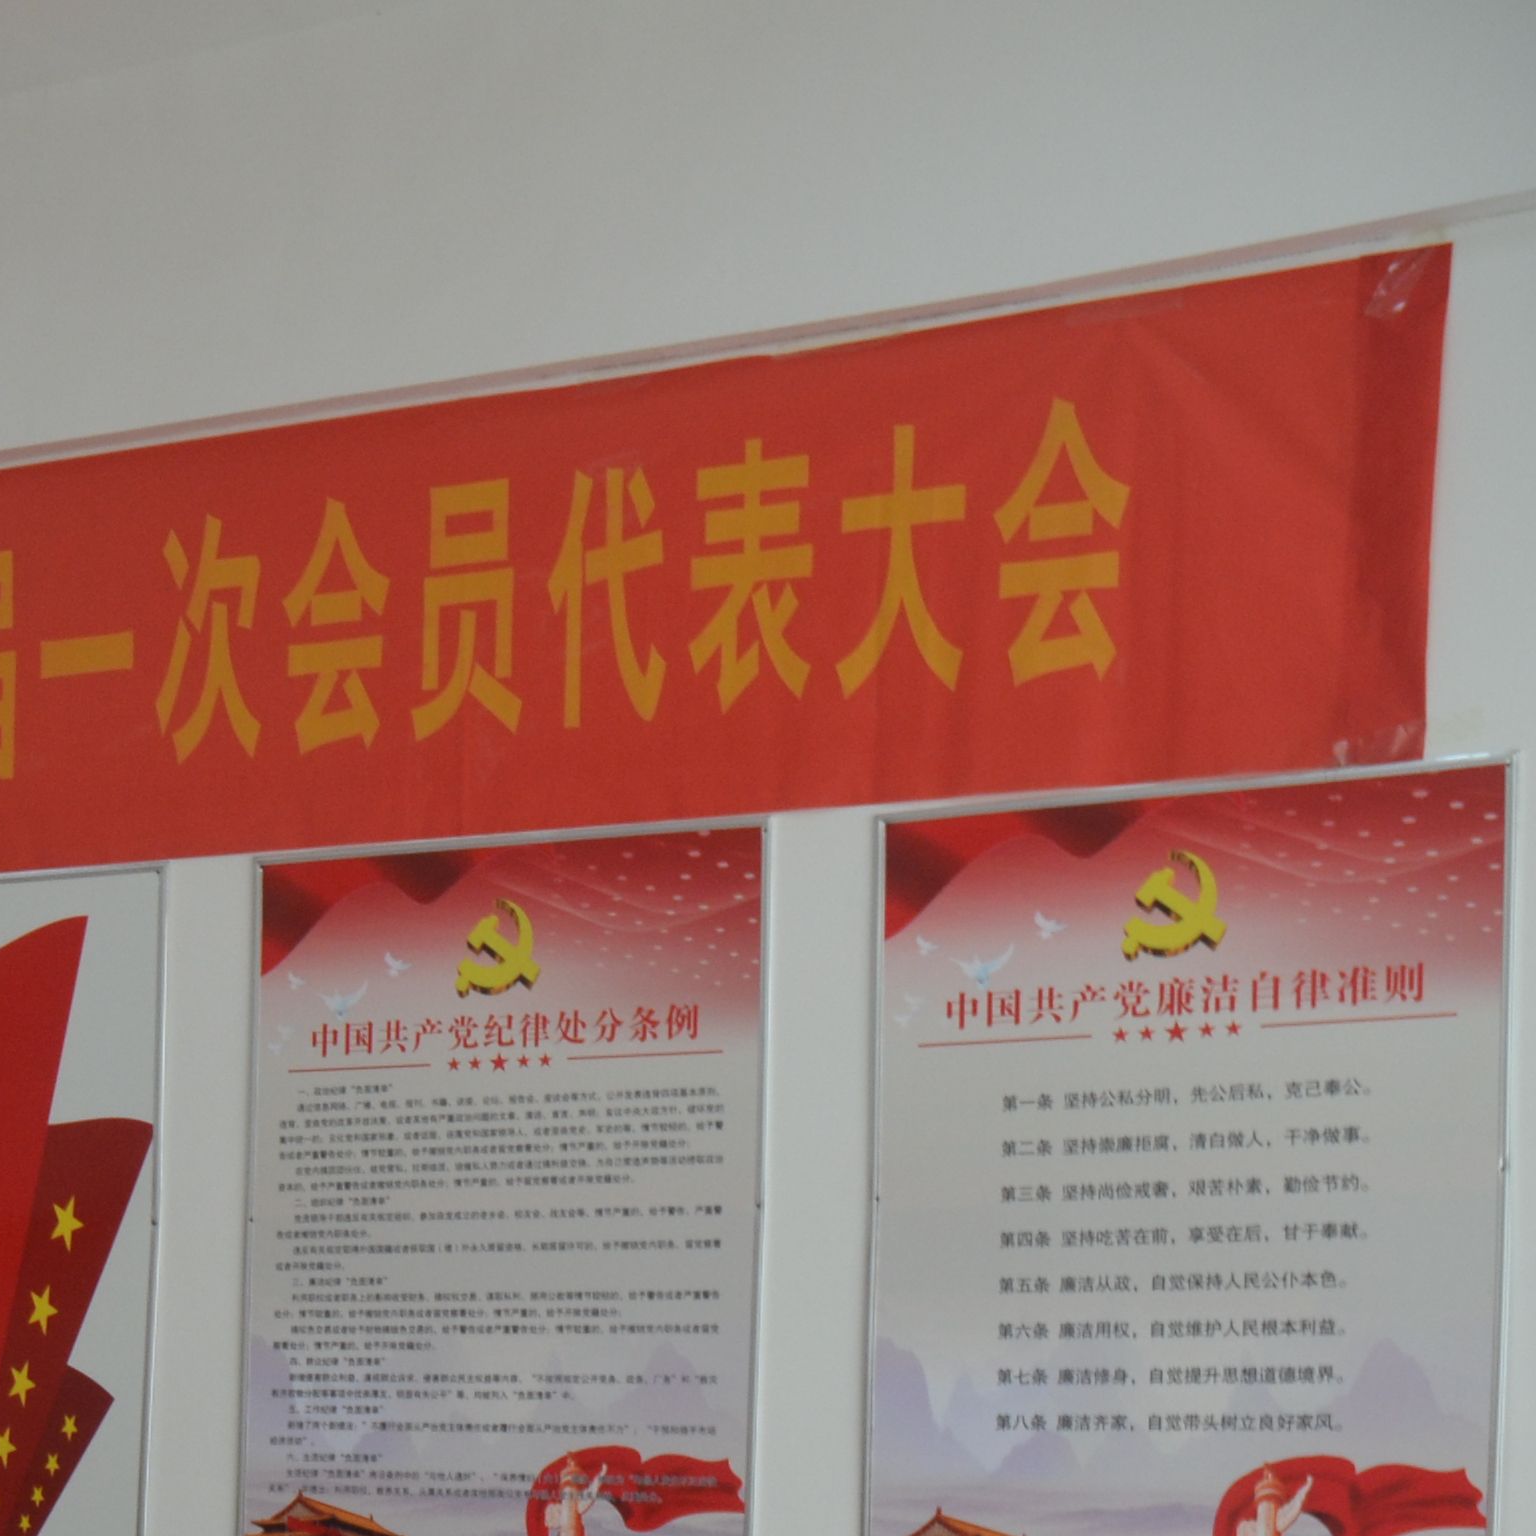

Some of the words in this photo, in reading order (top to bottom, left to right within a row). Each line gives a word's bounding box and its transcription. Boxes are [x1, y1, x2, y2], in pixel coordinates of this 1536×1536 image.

[944, 959, 1426, 1033] 中国共产党廉洁自律准则
[309, 1002, 700, 1061] 中国共产党纪律处分条例
